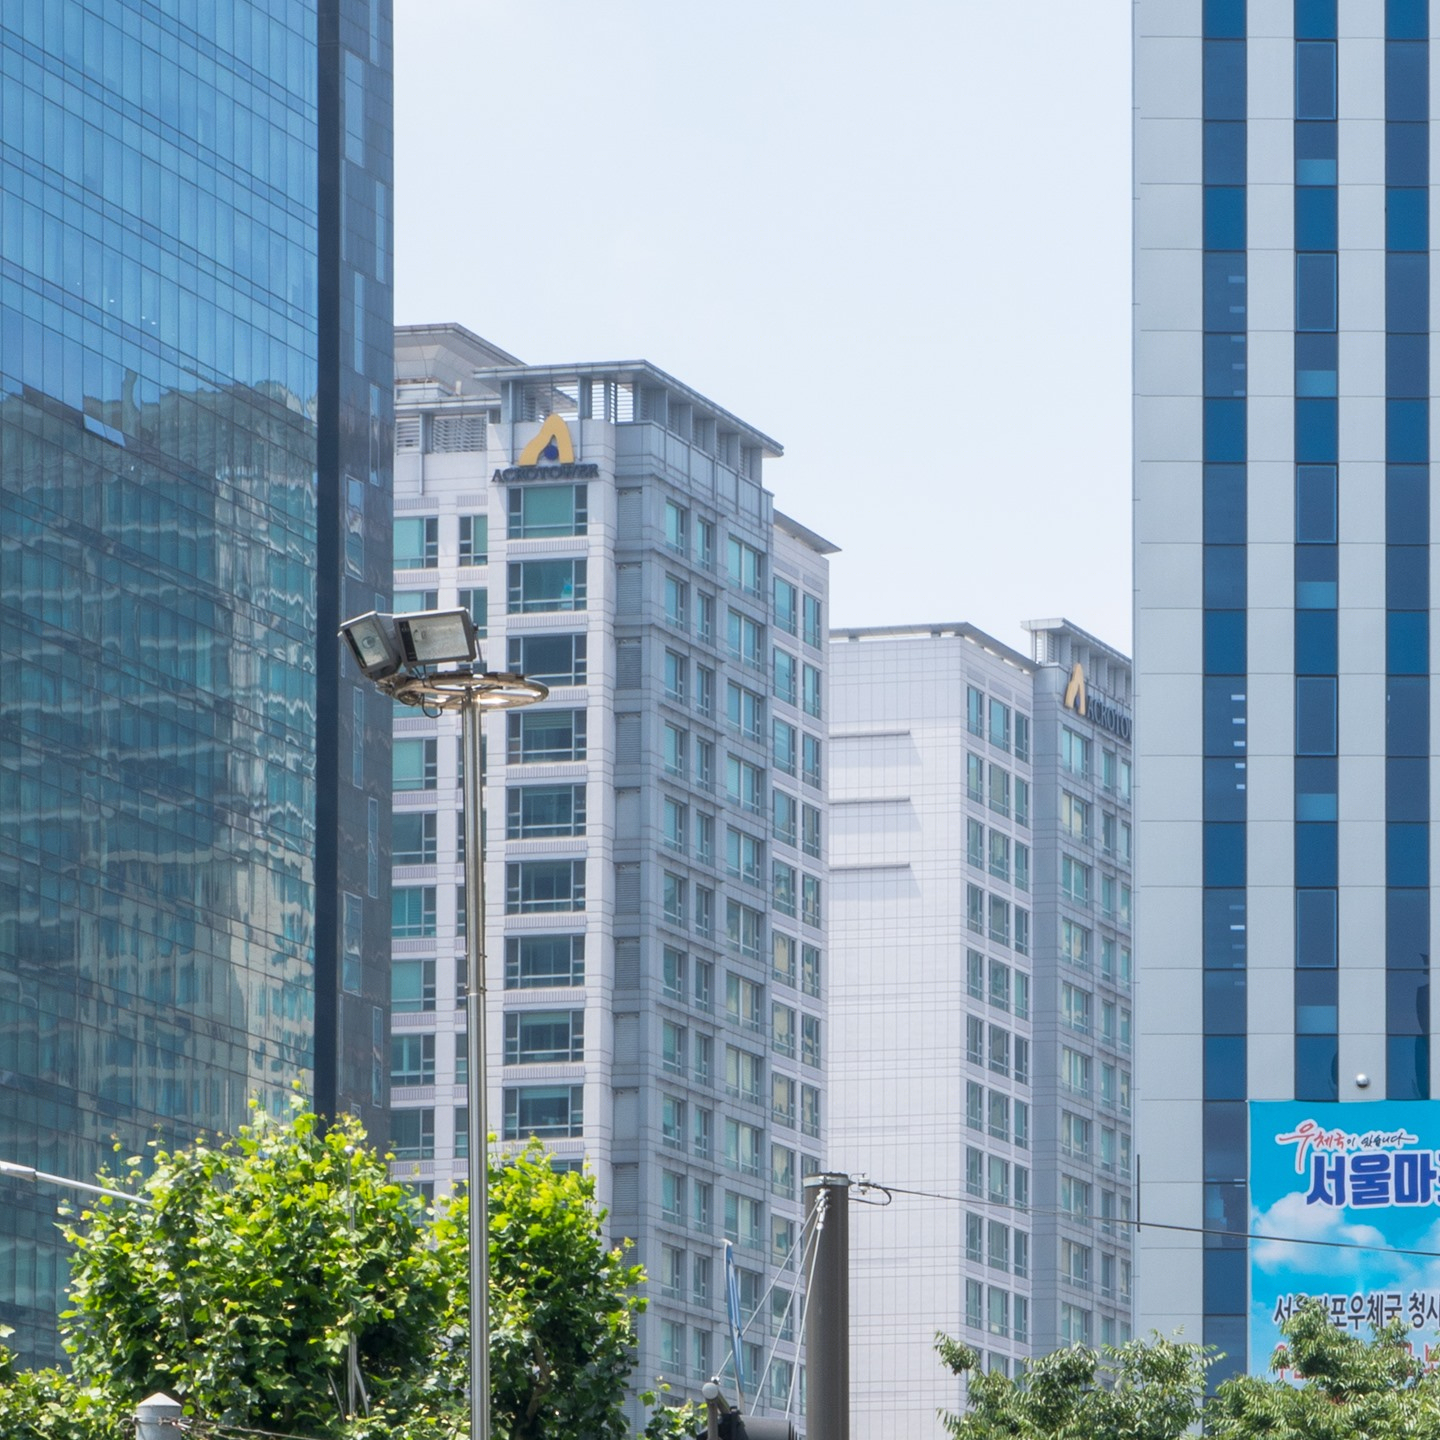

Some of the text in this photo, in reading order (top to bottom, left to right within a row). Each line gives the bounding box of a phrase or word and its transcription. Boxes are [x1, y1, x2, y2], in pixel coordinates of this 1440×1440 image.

[491, 464, 599, 482] ACROTOWER
[1087, 695, 1132, 743] ACROTO
[1274, 1294, 1402, 1330] 서포우체국
